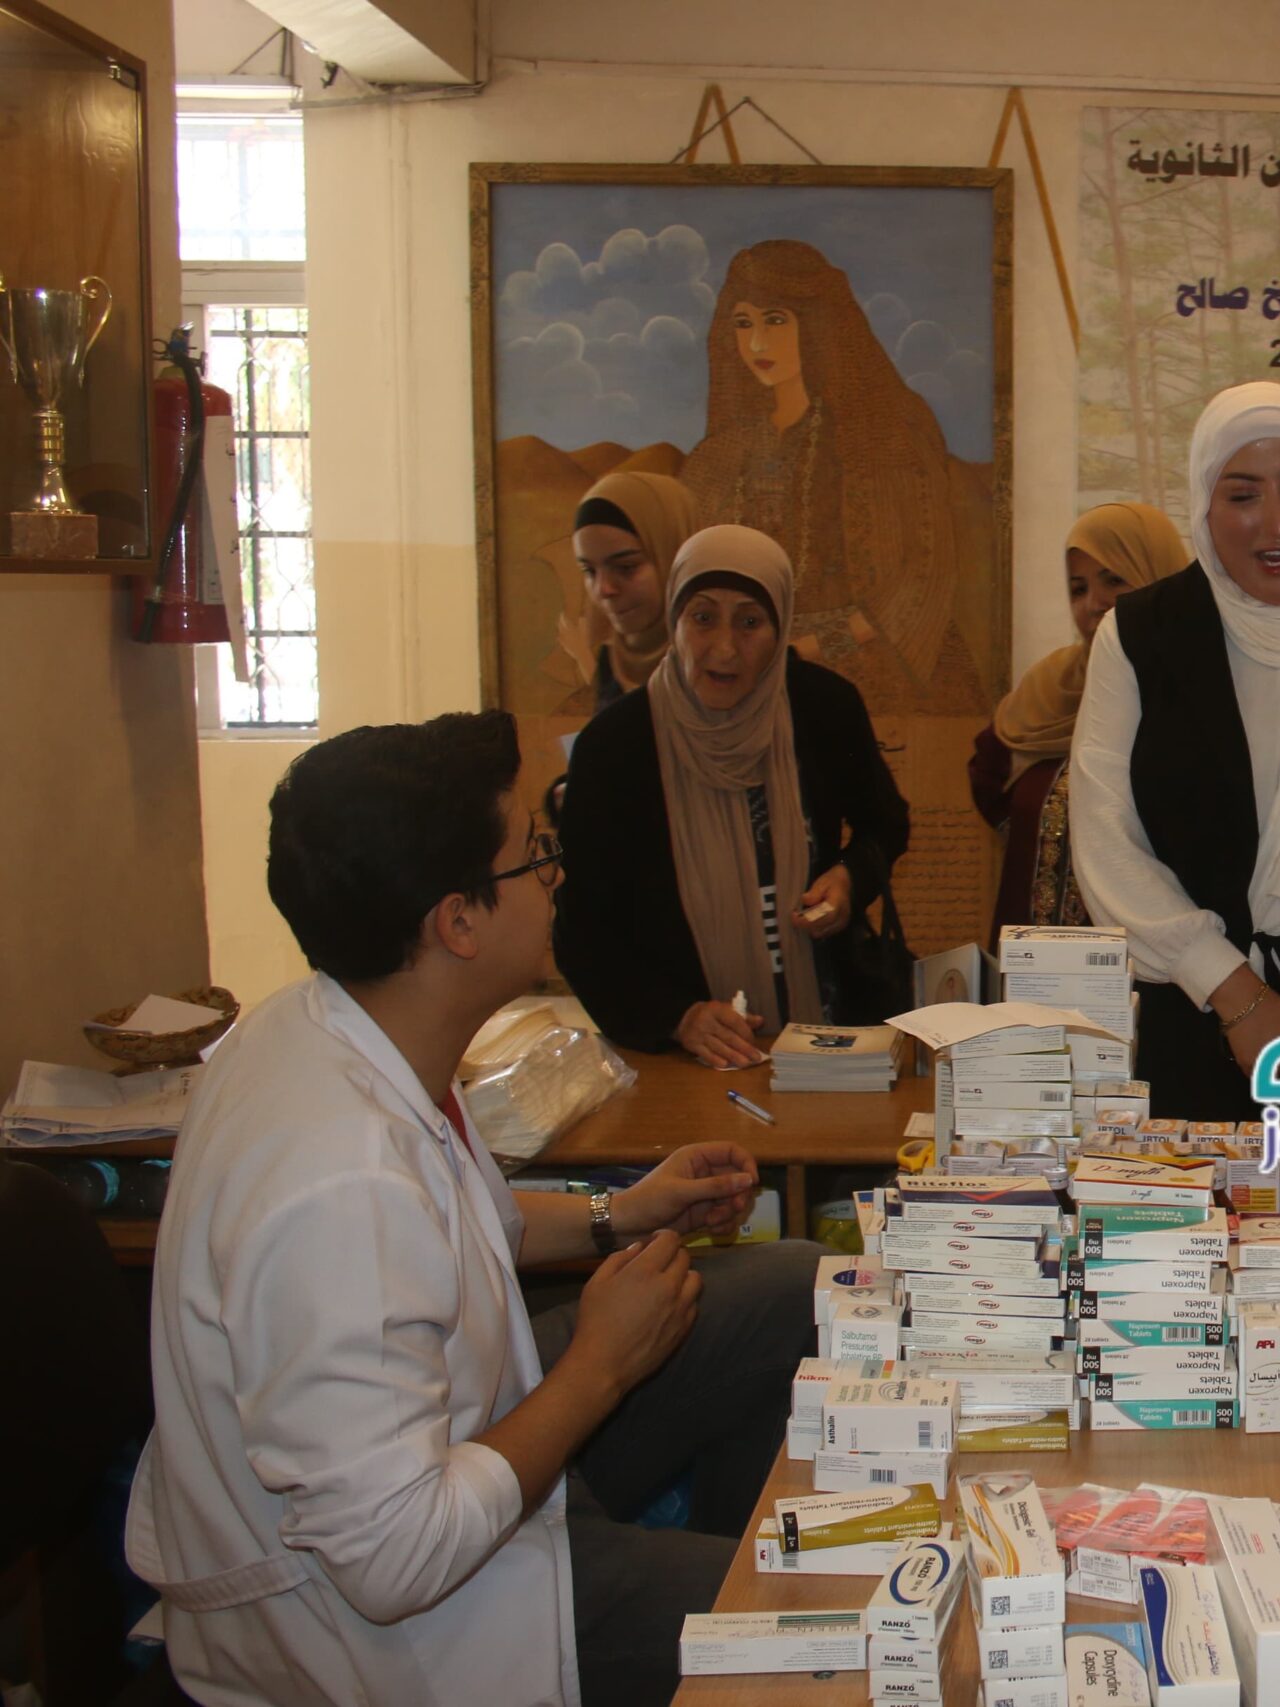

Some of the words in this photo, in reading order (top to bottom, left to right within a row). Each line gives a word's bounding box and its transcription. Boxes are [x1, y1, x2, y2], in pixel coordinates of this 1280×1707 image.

[1126, 140, 1251, 183] الثانوية
[1174, 278, 1250, 318] صالح
[1190, 1238, 1223, 1247] Tablets
[1085, 1246, 1102, 1255] 500
[1178, 1249, 1224, 1259] Naproxen
[1172, 1269, 1206, 1279] Tablets
[1067, 1278, 1084, 1286] 500
[1161, 1281, 1206, 1290] Naproxen
[1185, 1300, 1217, 1309] Tablets
[1080, 1306, 1097, 1315] 500
[1173, 1311, 1218, 1321] Naproxen
[1206, 1325, 1222, 1333] 500
[1187, 1351, 1220, 1360] Tablets
[1083, 1360, 1100, 1369] 500
[1176, 1362, 1221, 1372] Naproxen
[1199, 1376, 1232, 1384] Tablets
[1095, 1387, 1112, 1396] 500
[1188, 1387, 1233, 1396] Naproxen
[1216, 1408, 1233, 1417] 500
[827, 1415, 836, 1445] Asthalin
[1082, 1650, 1099, 1686] Capsules
